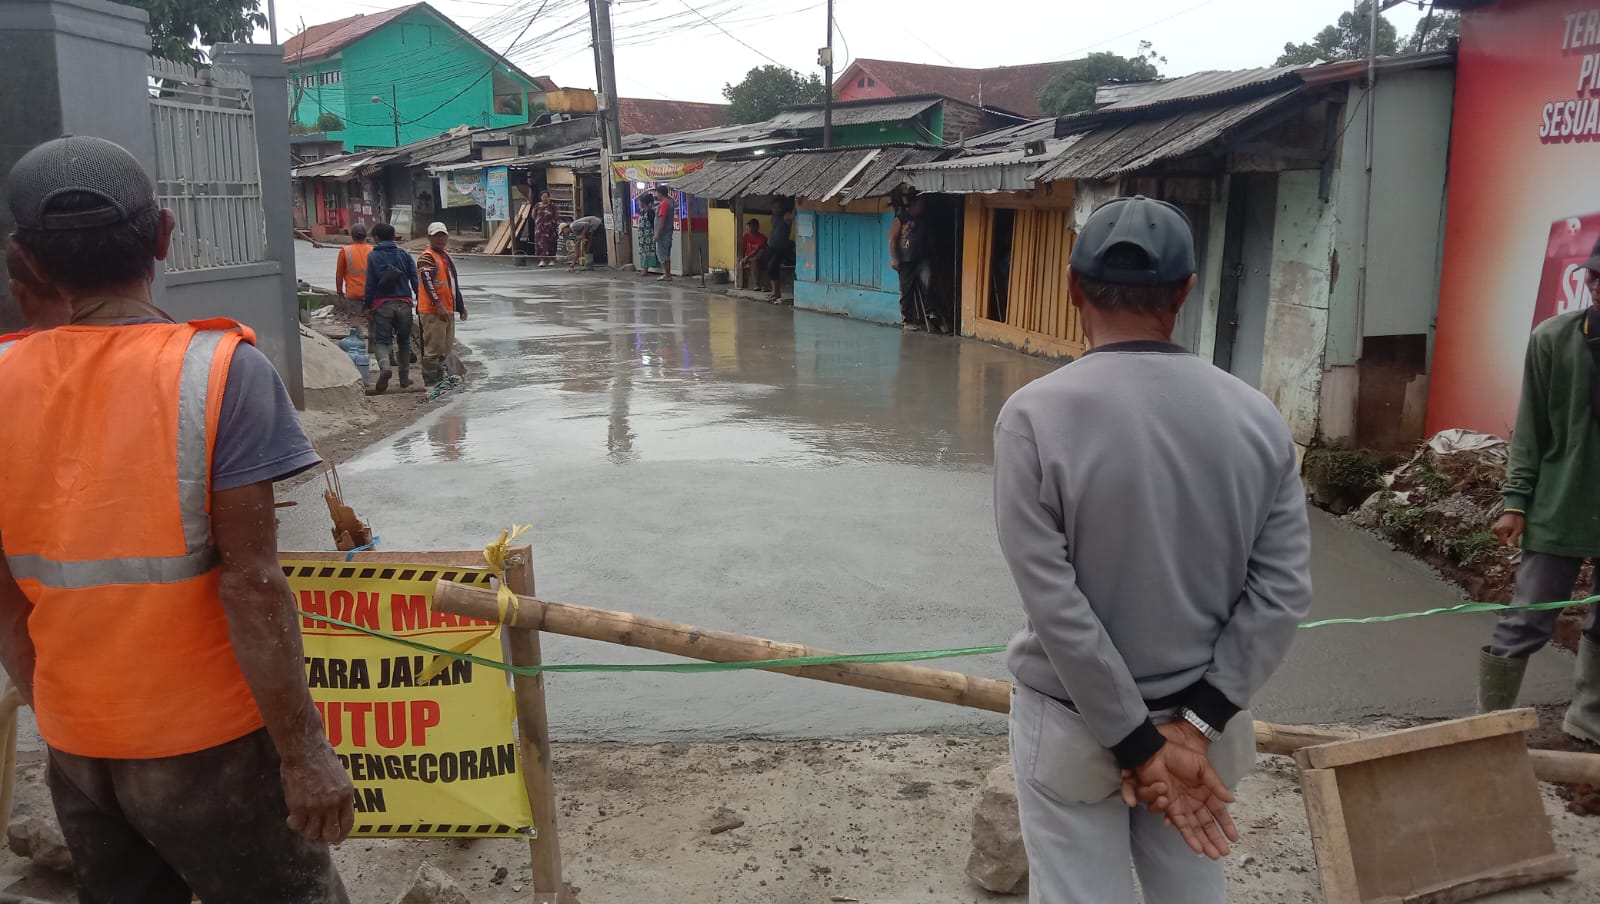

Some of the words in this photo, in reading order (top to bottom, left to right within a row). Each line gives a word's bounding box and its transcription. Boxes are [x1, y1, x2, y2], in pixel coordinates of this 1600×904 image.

[1562, 9, 1600, 50] TER
[292, 590, 381, 631] HON
[377, 654, 472, 688] JALAN
